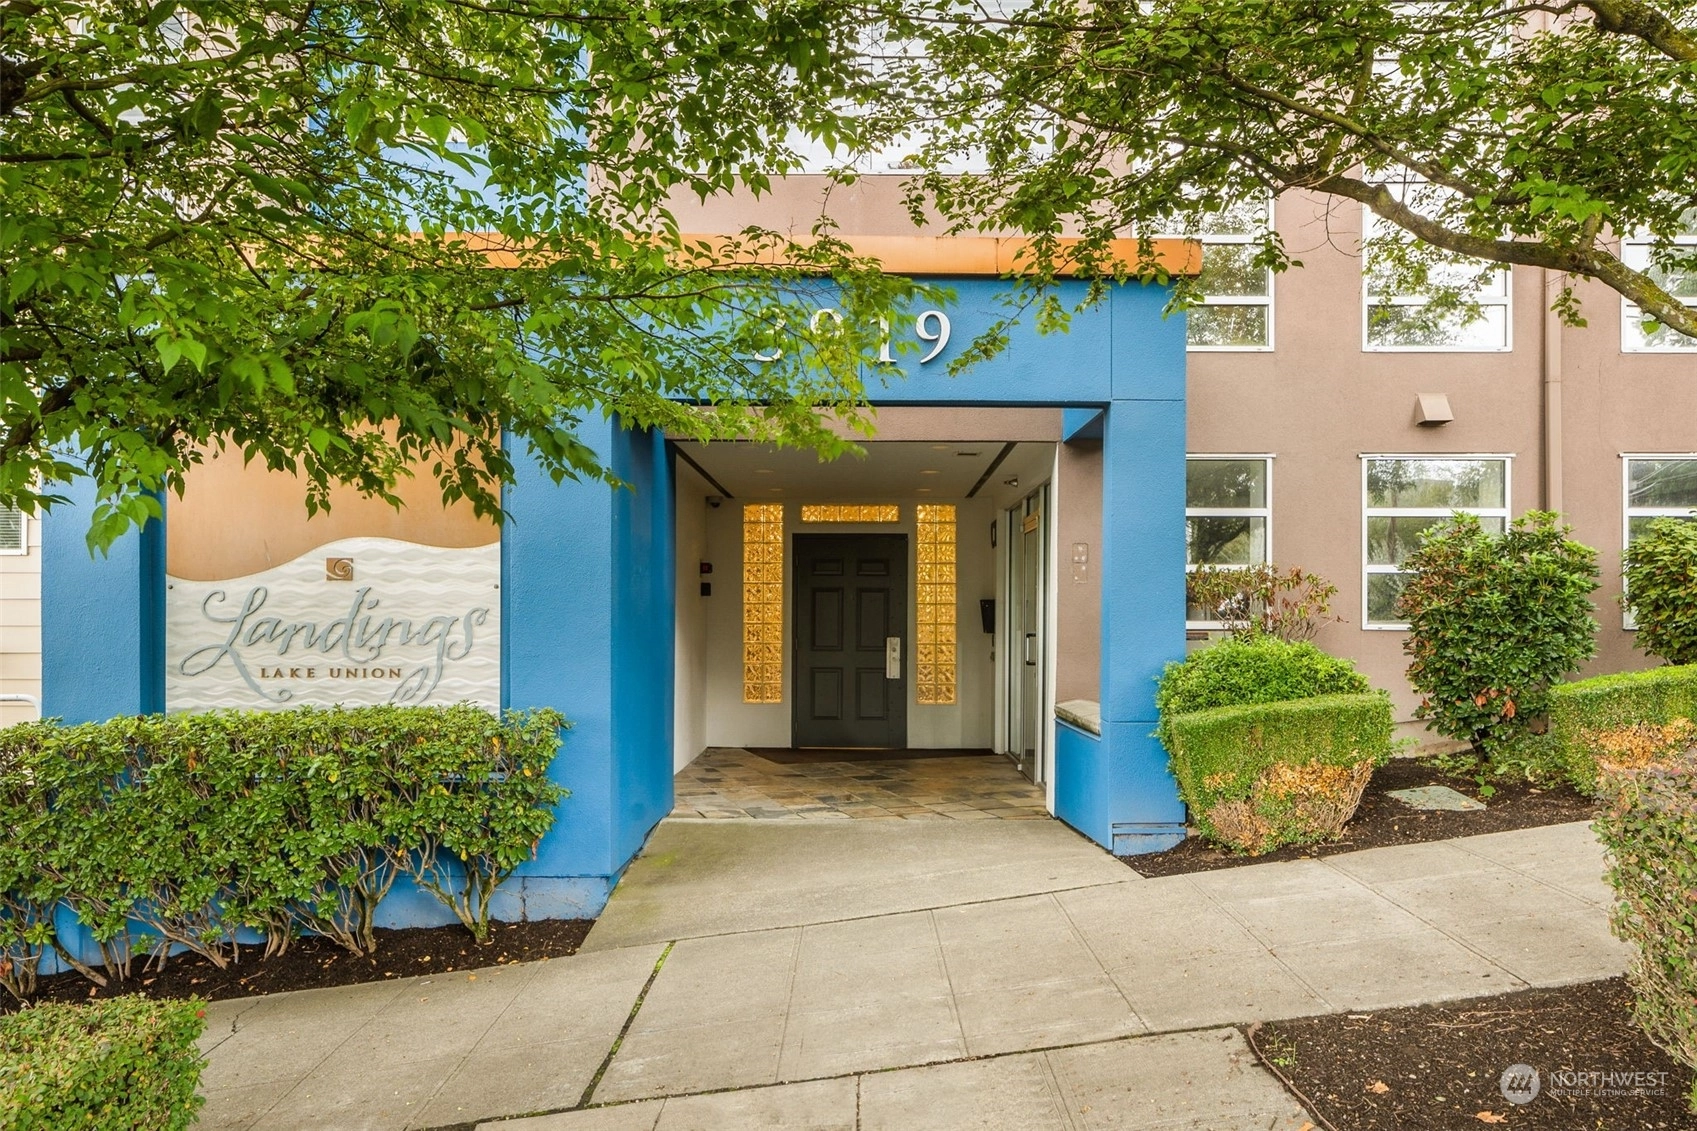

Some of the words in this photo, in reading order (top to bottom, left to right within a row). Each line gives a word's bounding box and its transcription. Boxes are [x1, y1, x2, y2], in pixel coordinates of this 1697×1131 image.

[179, 586, 489, 704] Landings
[260, 667, 316, 679] LAKE
[329, 667, 403, 679] UNION
